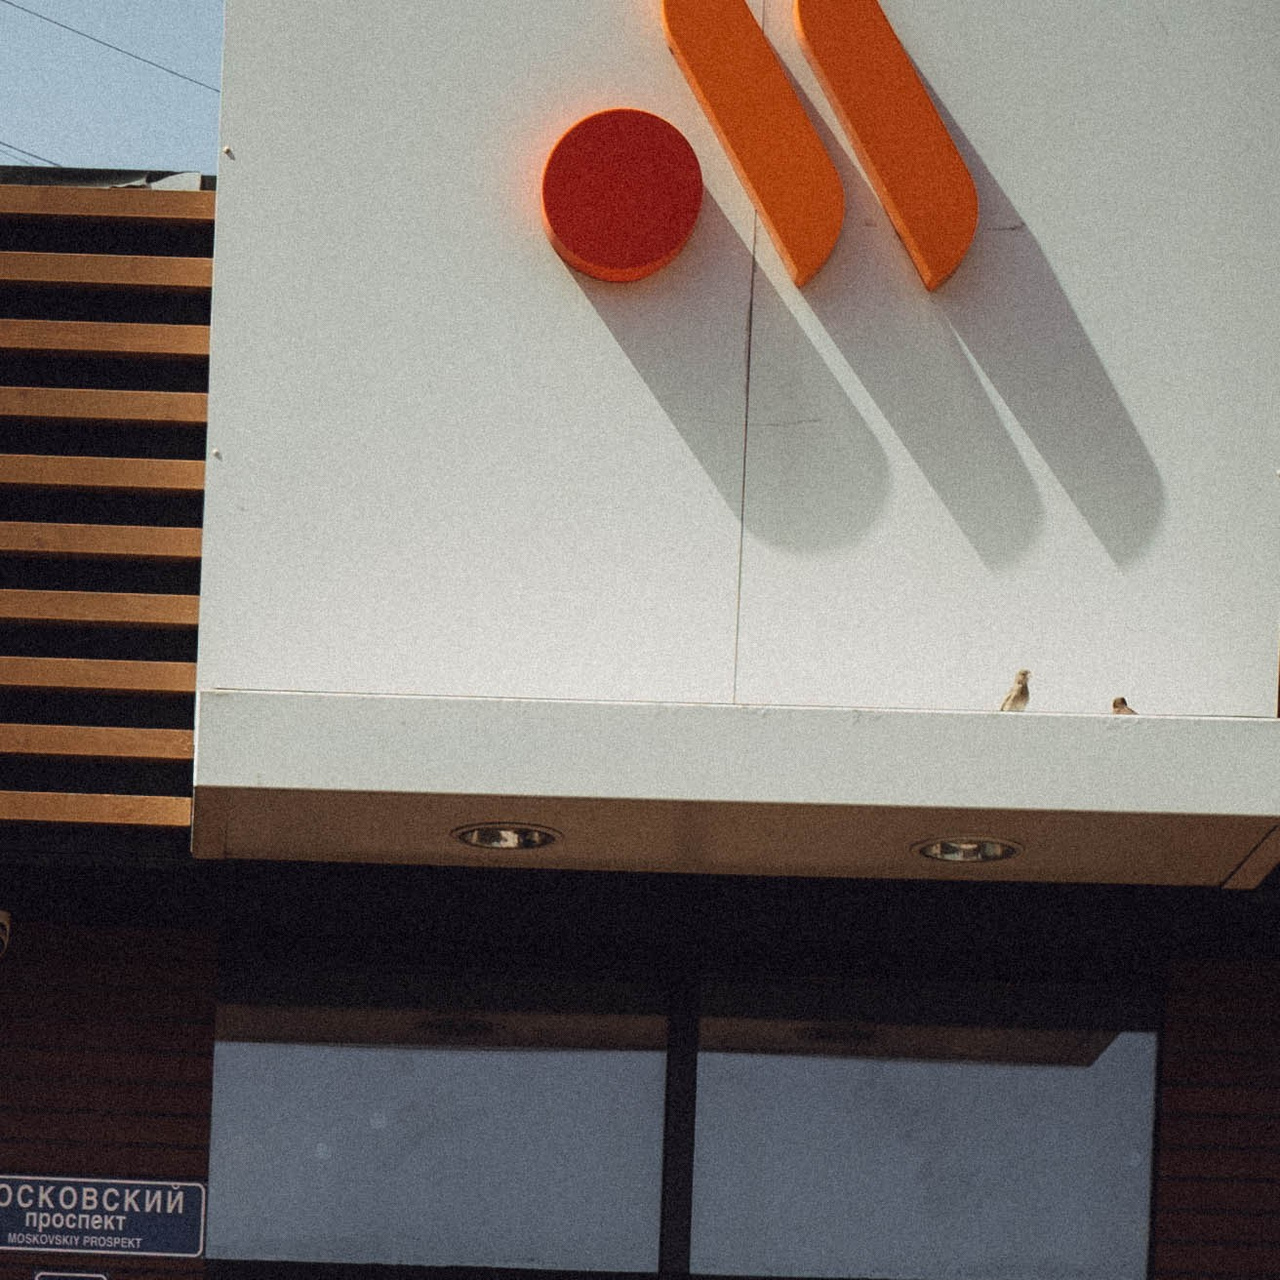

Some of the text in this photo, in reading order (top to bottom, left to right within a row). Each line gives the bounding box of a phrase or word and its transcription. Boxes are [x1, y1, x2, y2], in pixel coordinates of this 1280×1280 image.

[25, 1211, 126, 1232] проспект
[7, 1232, 142, 1249] MOSKOVSKIY PROSPEKT
